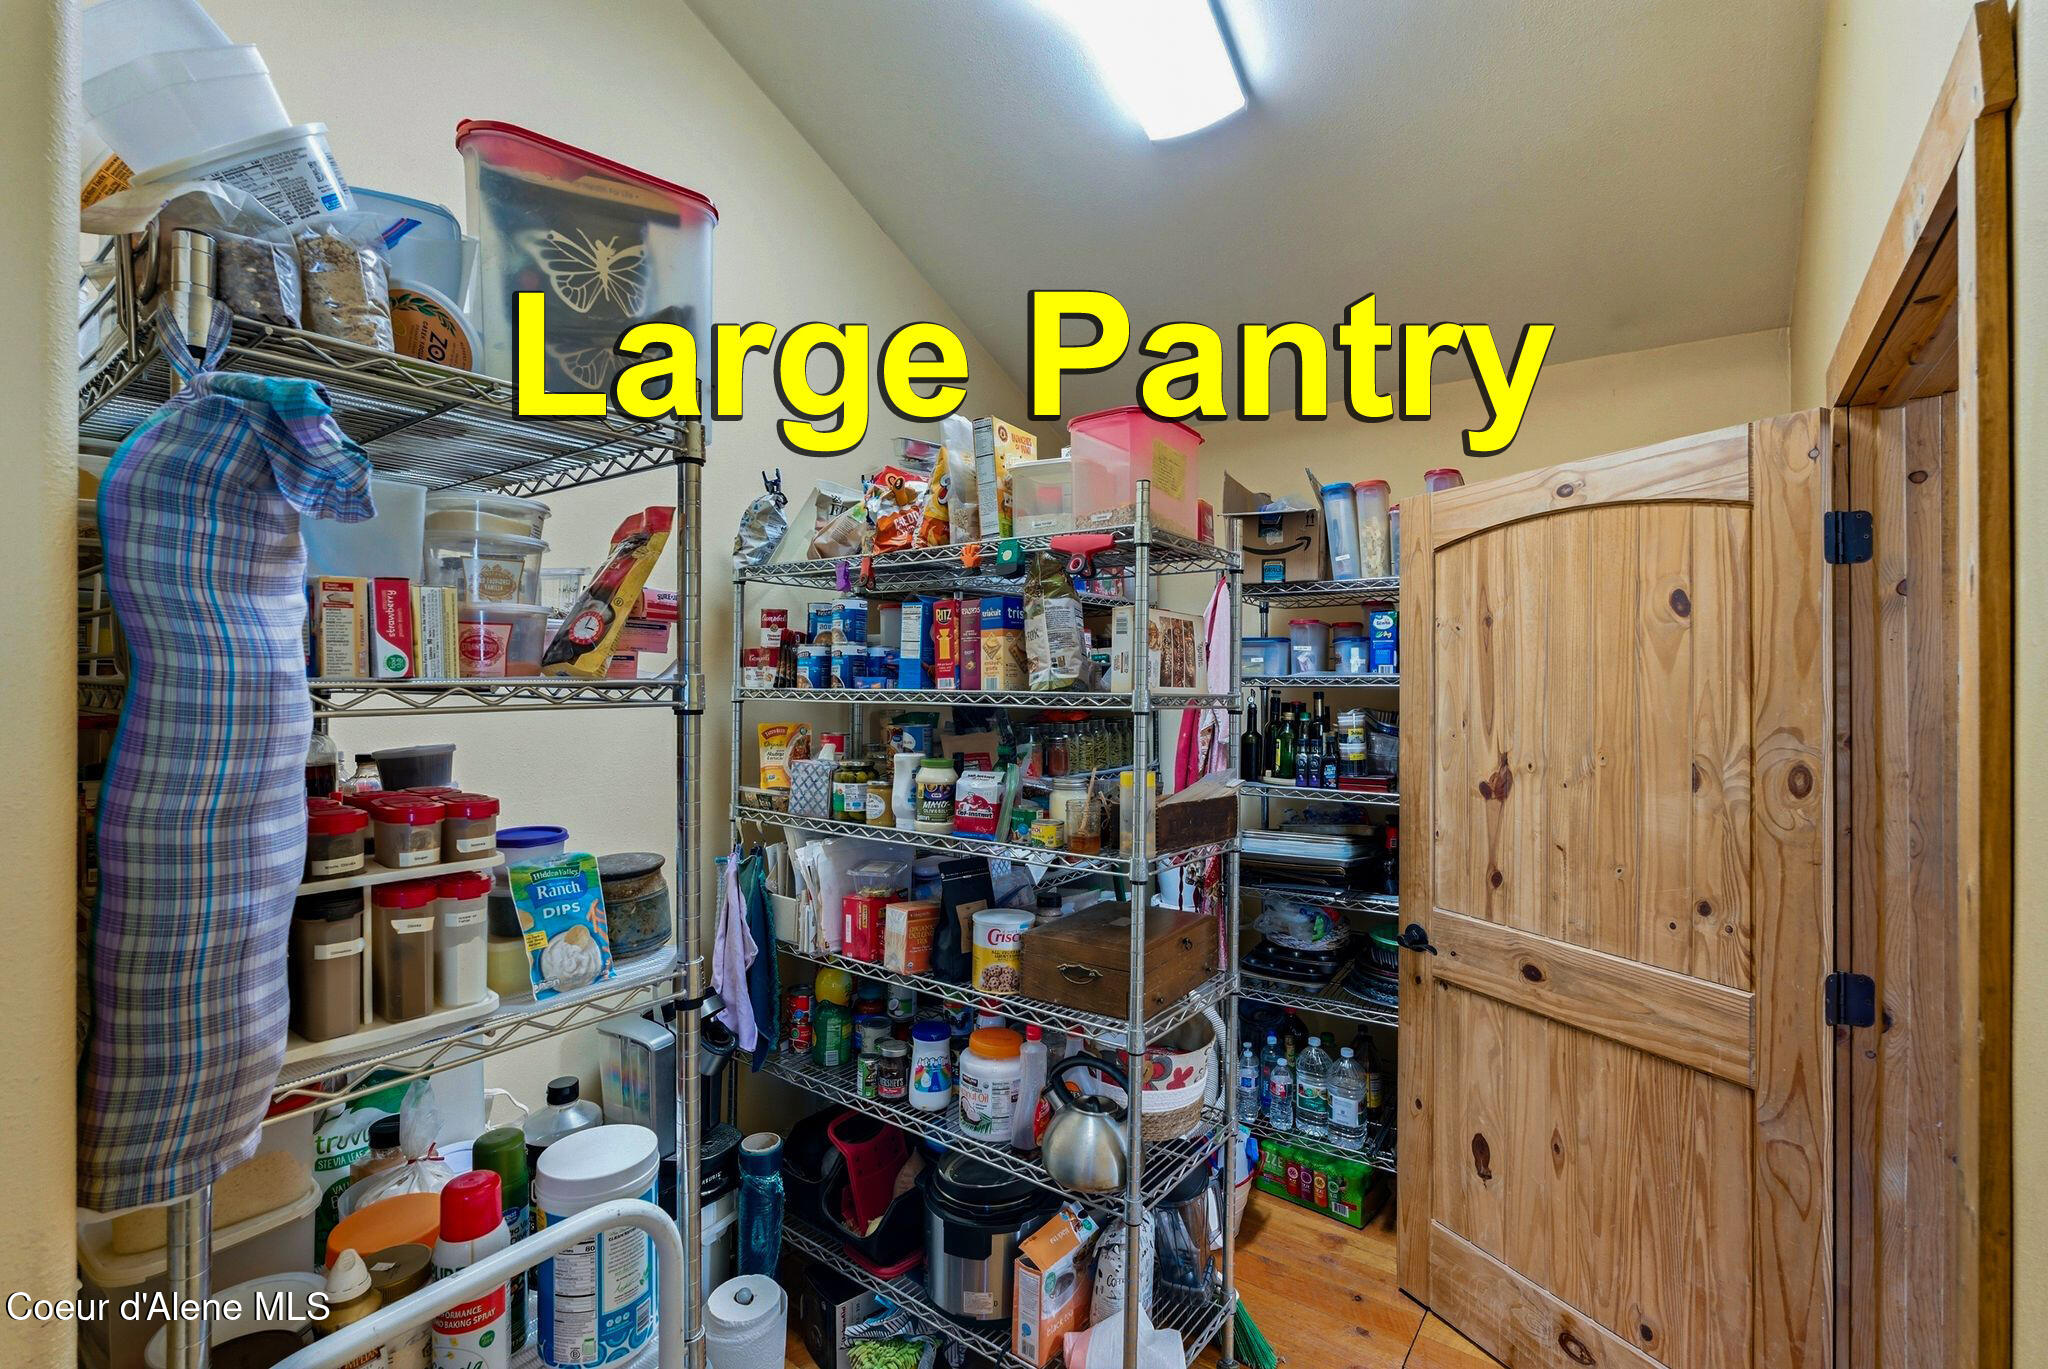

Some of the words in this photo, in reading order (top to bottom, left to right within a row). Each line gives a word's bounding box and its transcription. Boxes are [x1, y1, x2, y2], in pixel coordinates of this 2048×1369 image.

[386, 590, 396, 638] strawberry
[936, 609, 952, 622] RITZ
[982, 608, 1002, 617] triscuit
[532, 868, 558, 881] Hidden
[559, 867, 579, 878] Valley
[536, 881, 581, 900] Ranch
[542, 902, 580, 920] DIPS
[987, 928, 1022, 946] Crisc
[318, 1157, 346, 1170] STEVIA
[444, 1318, 472, 1329] BAKING
[473, 1307, 496, 1324] SPRAY
